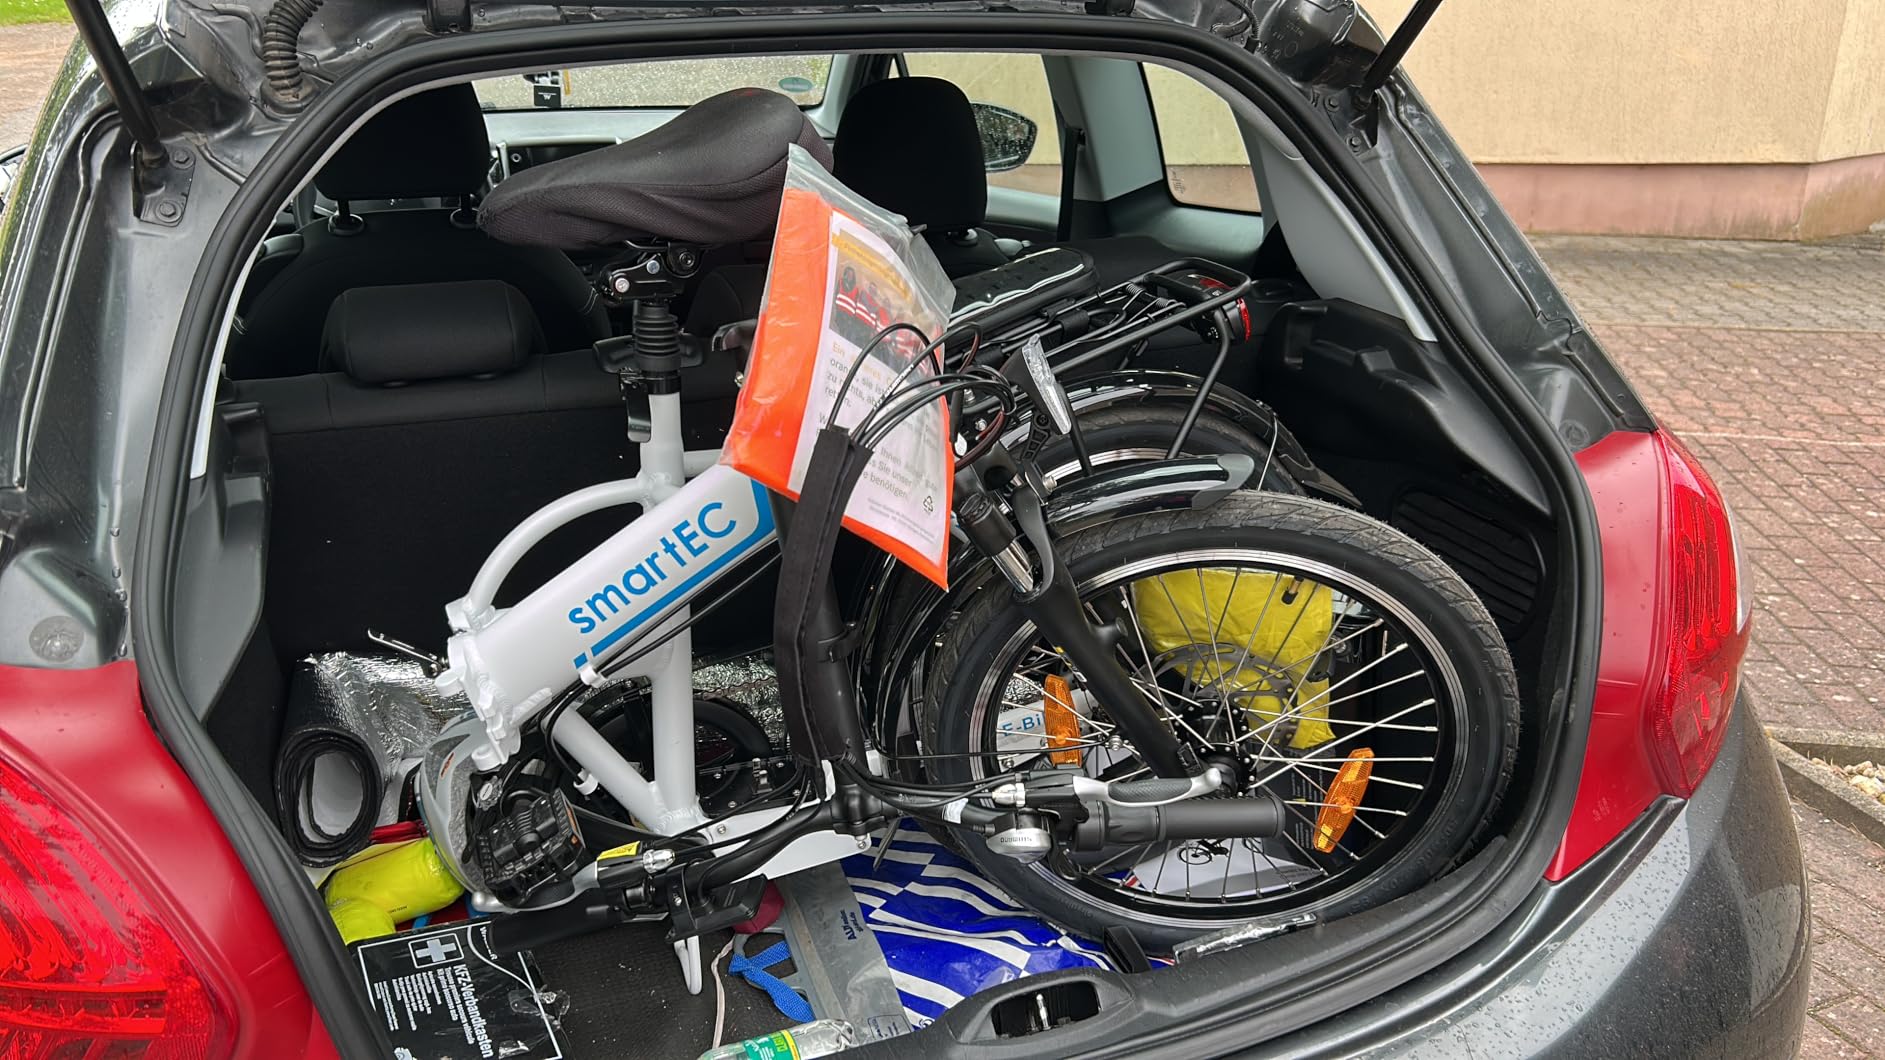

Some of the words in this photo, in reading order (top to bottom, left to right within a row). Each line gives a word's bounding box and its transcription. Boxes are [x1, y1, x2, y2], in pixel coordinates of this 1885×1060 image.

[568, 502, 737, 634] smartEC
[1002, 712, 1045, 737] E-Bi
[453, 963, 494, 1059] KFZ-Verbandkasten
